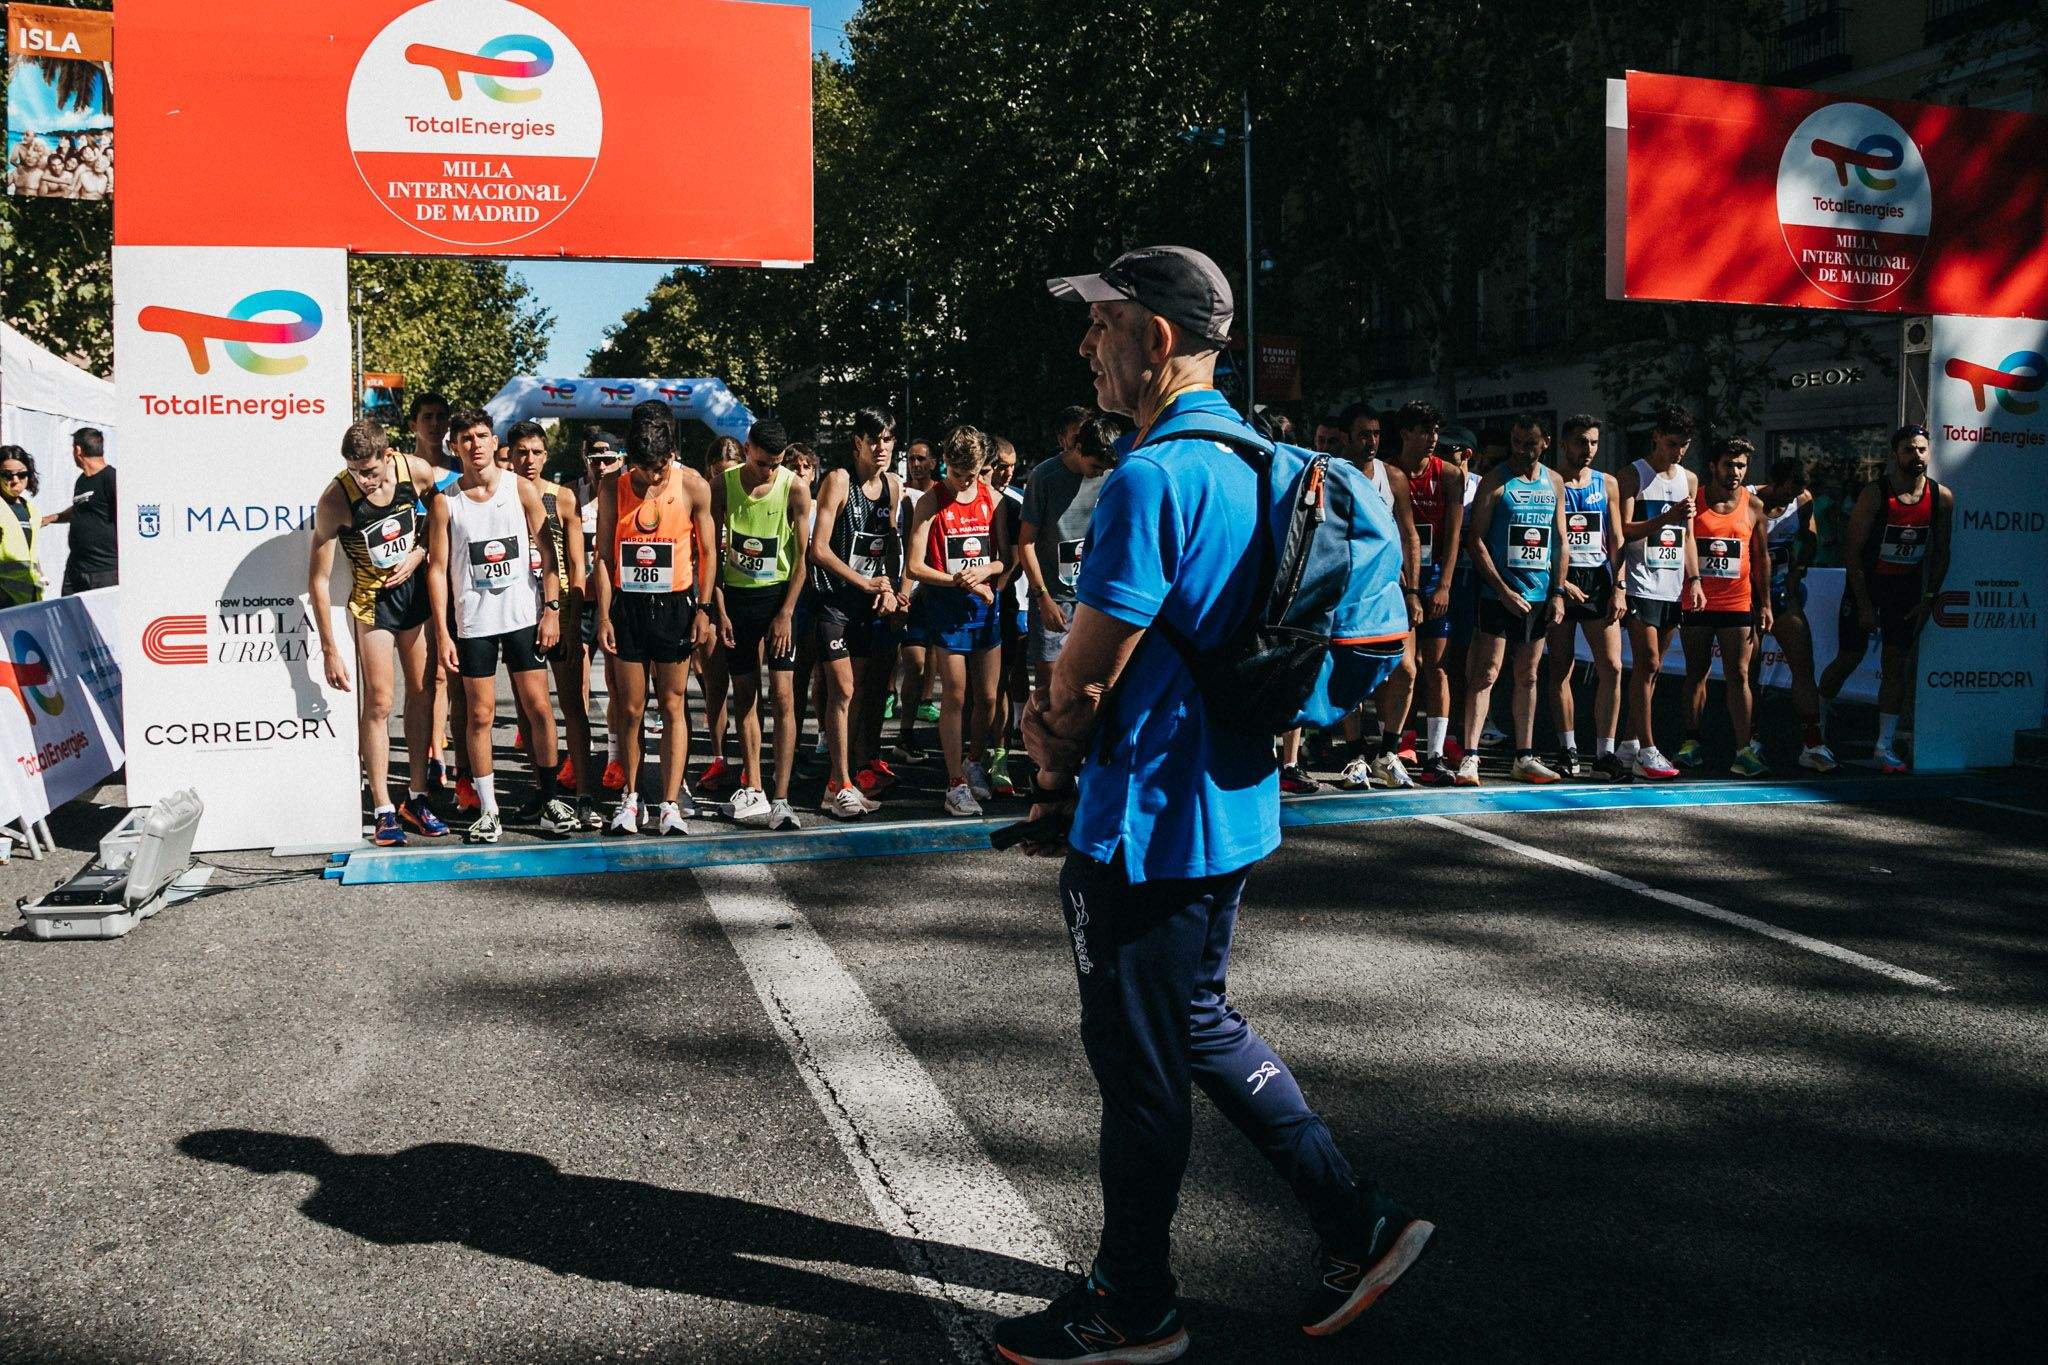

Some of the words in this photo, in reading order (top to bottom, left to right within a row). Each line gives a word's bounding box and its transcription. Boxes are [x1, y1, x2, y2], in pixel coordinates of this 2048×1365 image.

[20, 28, 82, 54] ISLA
[405, 116, 555, 140] TotalEnergies
[443, 160, 513, 179] MILLA
[416, 204, 447, 221] DE
[452, 205, 540, 222] MADRID
[1813, 197, 1904, 220] TotalEnergies
[1836, 234, 1878, 250] MILLA
[1818, 268, 1838, 282] DE
[1840, 270, 1894, 286] MADRID
[1791, 367, 1864, 389] GEOX
[139, 393, 326, 420] TotalEnergies
[1943, 424, 2046, 449] TotalEnergies
[1510, 512, 1554, 525] ATLETISM
[1963, 510, 2045, 532] MADRID
[383, 537, 407, 558] 240
[1567, 532, 1590, 545] 259
[1521, 546, 1542, 560] 254
[1659, 547, 1677, 560] 236
[484, 561, 511, 579] 290
[739, 554, 764, 571] 239
[1706, 557, 1729, 570] 249
[633, 567, 659, 583] 286
[1974, 580, 1990, 588] new
[1990, 579, 2020, 588] balance
[215, 599, 240, 608] new
[243, 596, 295, 607] balance
[1975, 591, 2030, 608] MILLA
[219, 612, 315, 635] MILLA
[1973, 612, 2037, 629] URBANA
[17, 730, 89, 779] TotalEnergies
